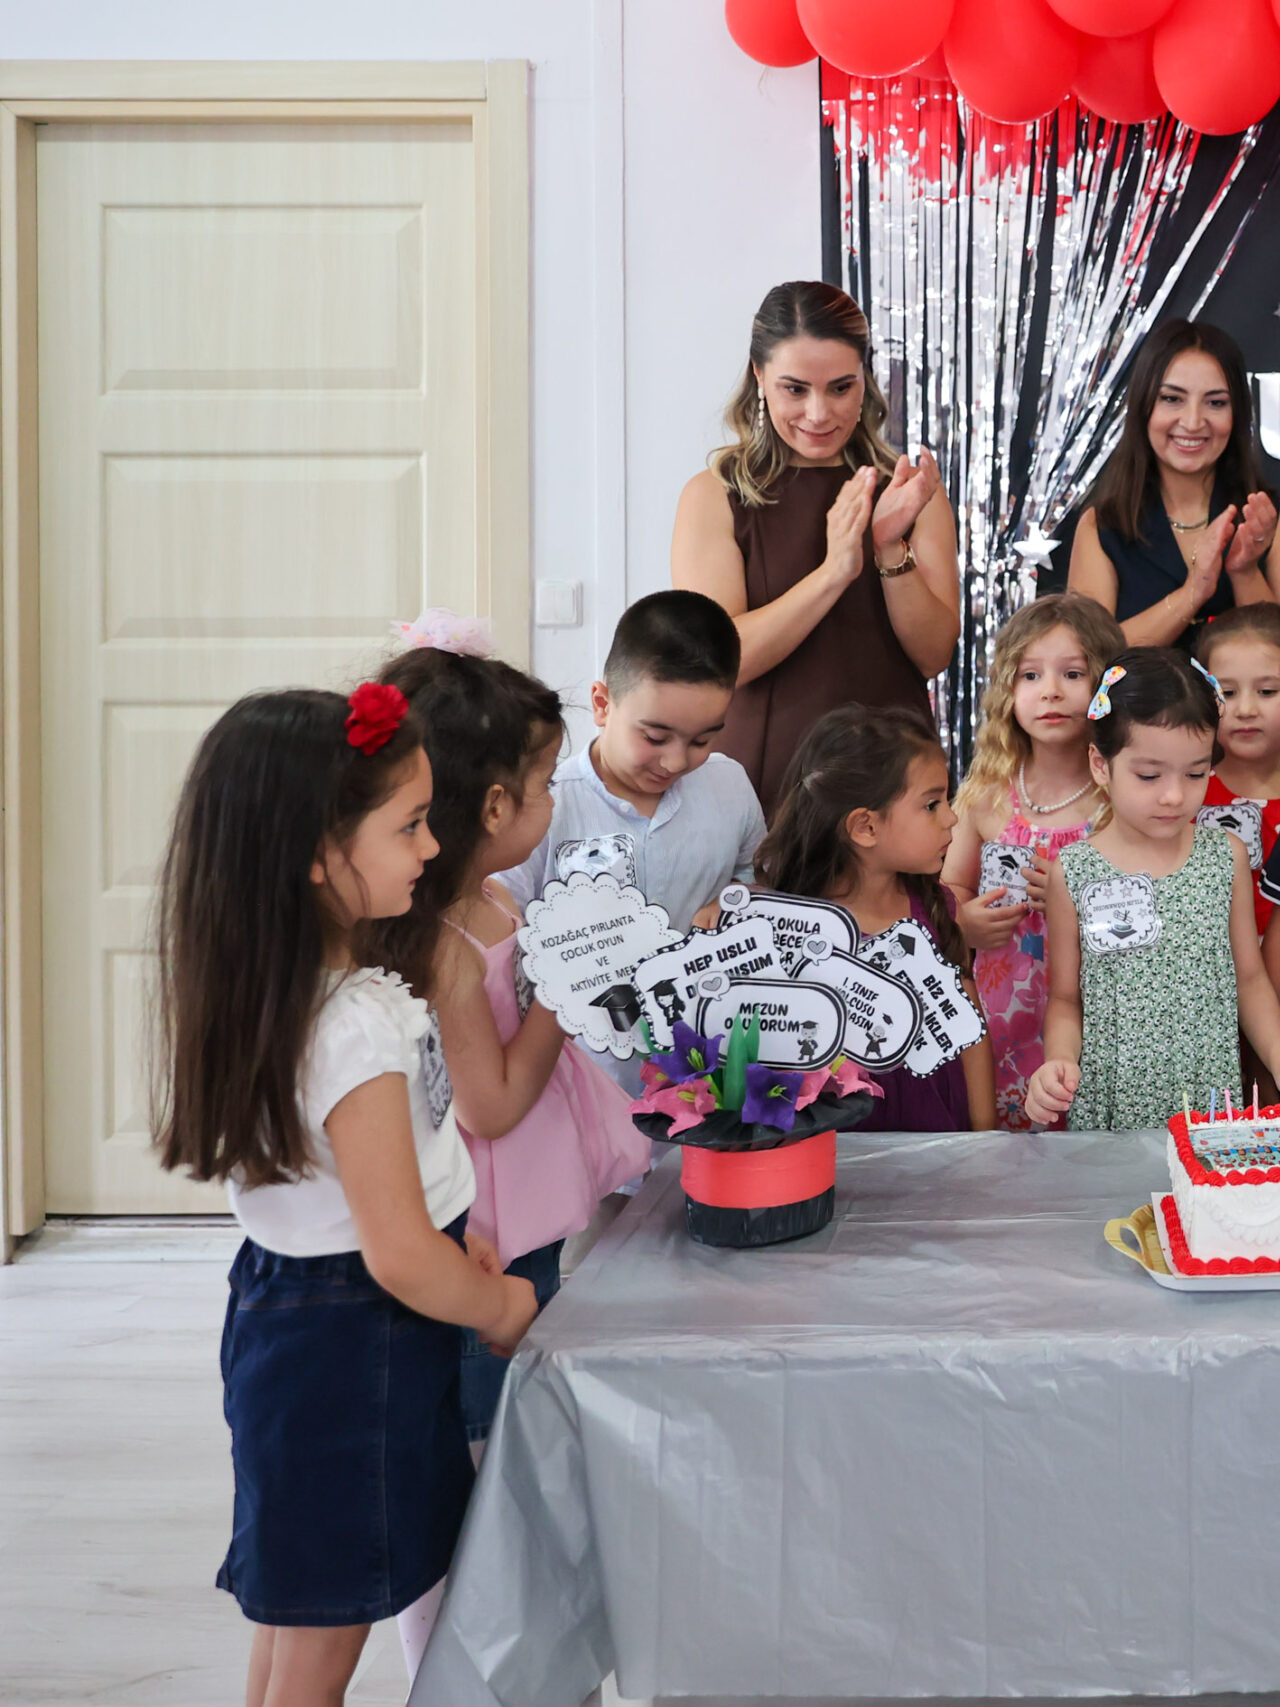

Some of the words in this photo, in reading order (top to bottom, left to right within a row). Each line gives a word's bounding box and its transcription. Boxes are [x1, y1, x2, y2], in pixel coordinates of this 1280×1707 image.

[540, 927, 590, 949] KOZAĞAÇ
[589, 914, 636, 934] PIRLANTA
[777, 917, 821, 934] OKULA
[560, 942, 597, 963] ÇOCUK
[596, 934, 625, 950] OYUN
[595, 955, 610, 967] VE
[683, 954, 713, 976] HEP
[716, 936, 758, 963] USLU
[570, 972, 613, 993] AKTİVİTE
[850, 981, 880, 1003] SINIF
[922, 974, 945, 1000] BİZ
[938, 998, 959, 1021] NE
